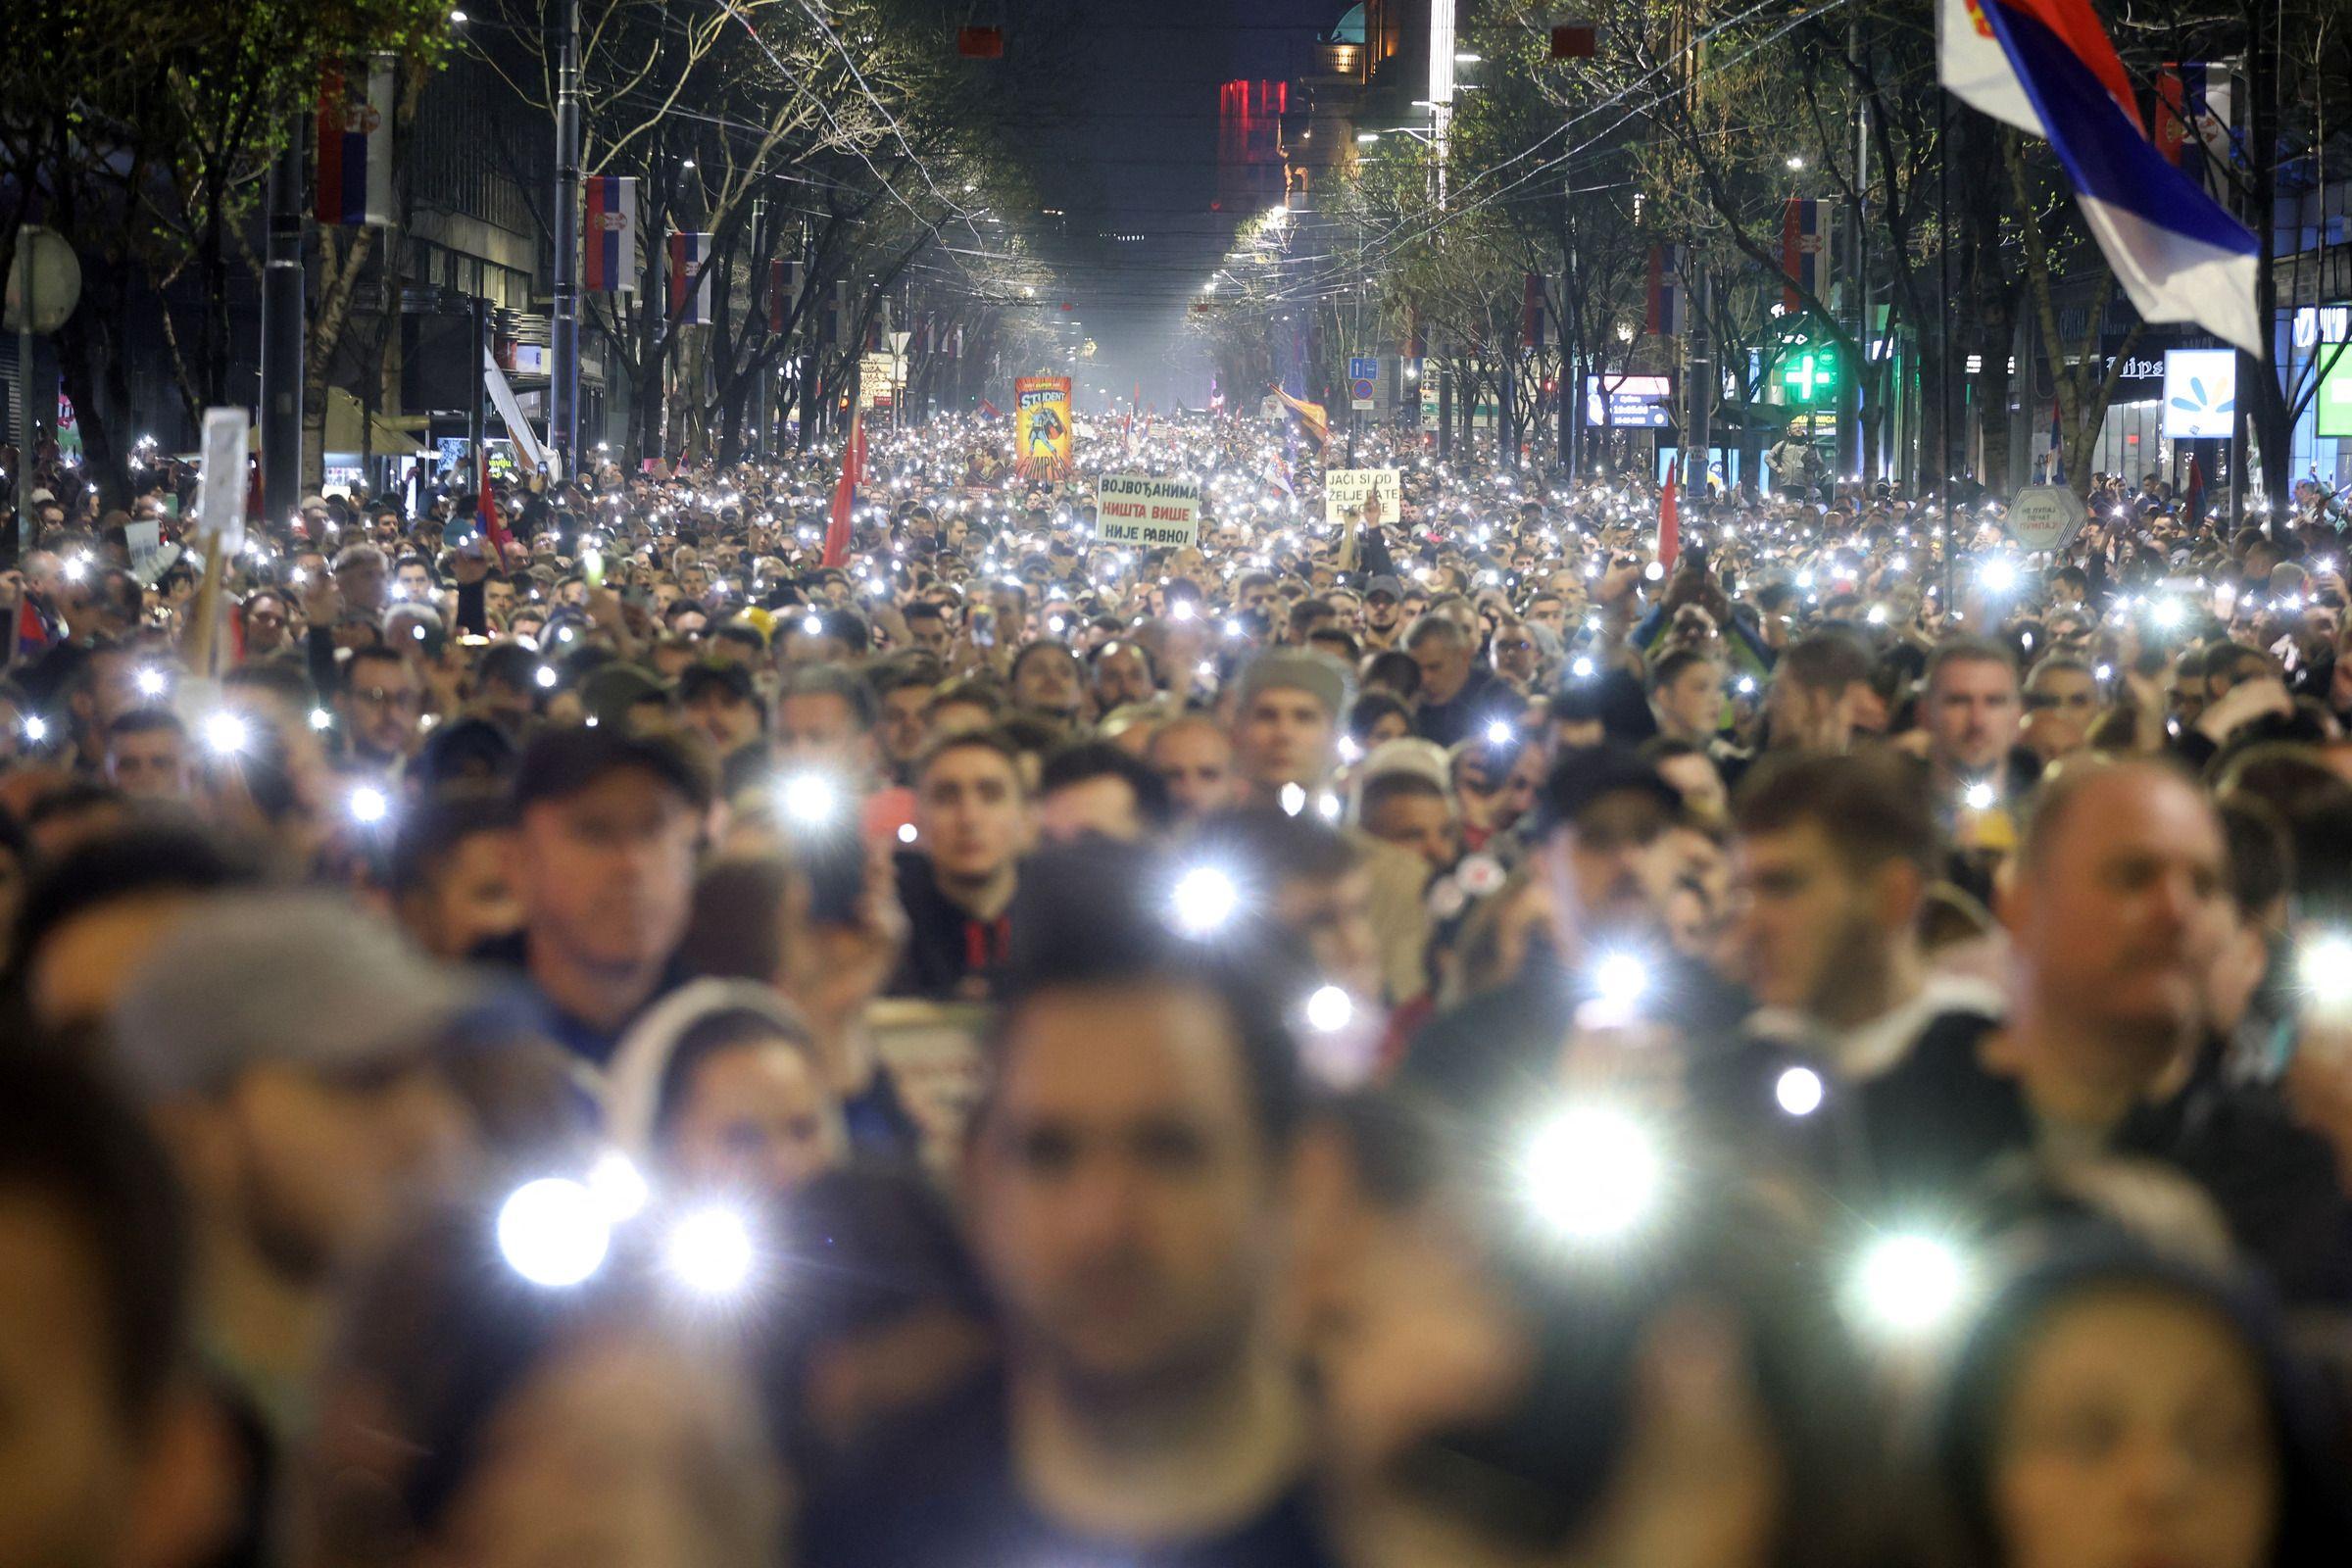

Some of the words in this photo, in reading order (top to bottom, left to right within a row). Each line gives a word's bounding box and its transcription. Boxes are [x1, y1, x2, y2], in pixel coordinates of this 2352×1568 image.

[1021, 391, 1066, 410] STUDENT
[1359, 473, 1370, 484] SI
[1375, 473, 1392, 484] OD
[1102, 478, 1198, 499] ВОЈВОЂАНИМА
[1385, 489, 1398, 500] TE
[1102, 502, 1147, 519] НИШТА
[1152, 506, 1190, 521] ВИШЕ
[1105, 524, 1140, 539] НИЈЕ
[1144, 527, 1189, 543] РАВНО!
